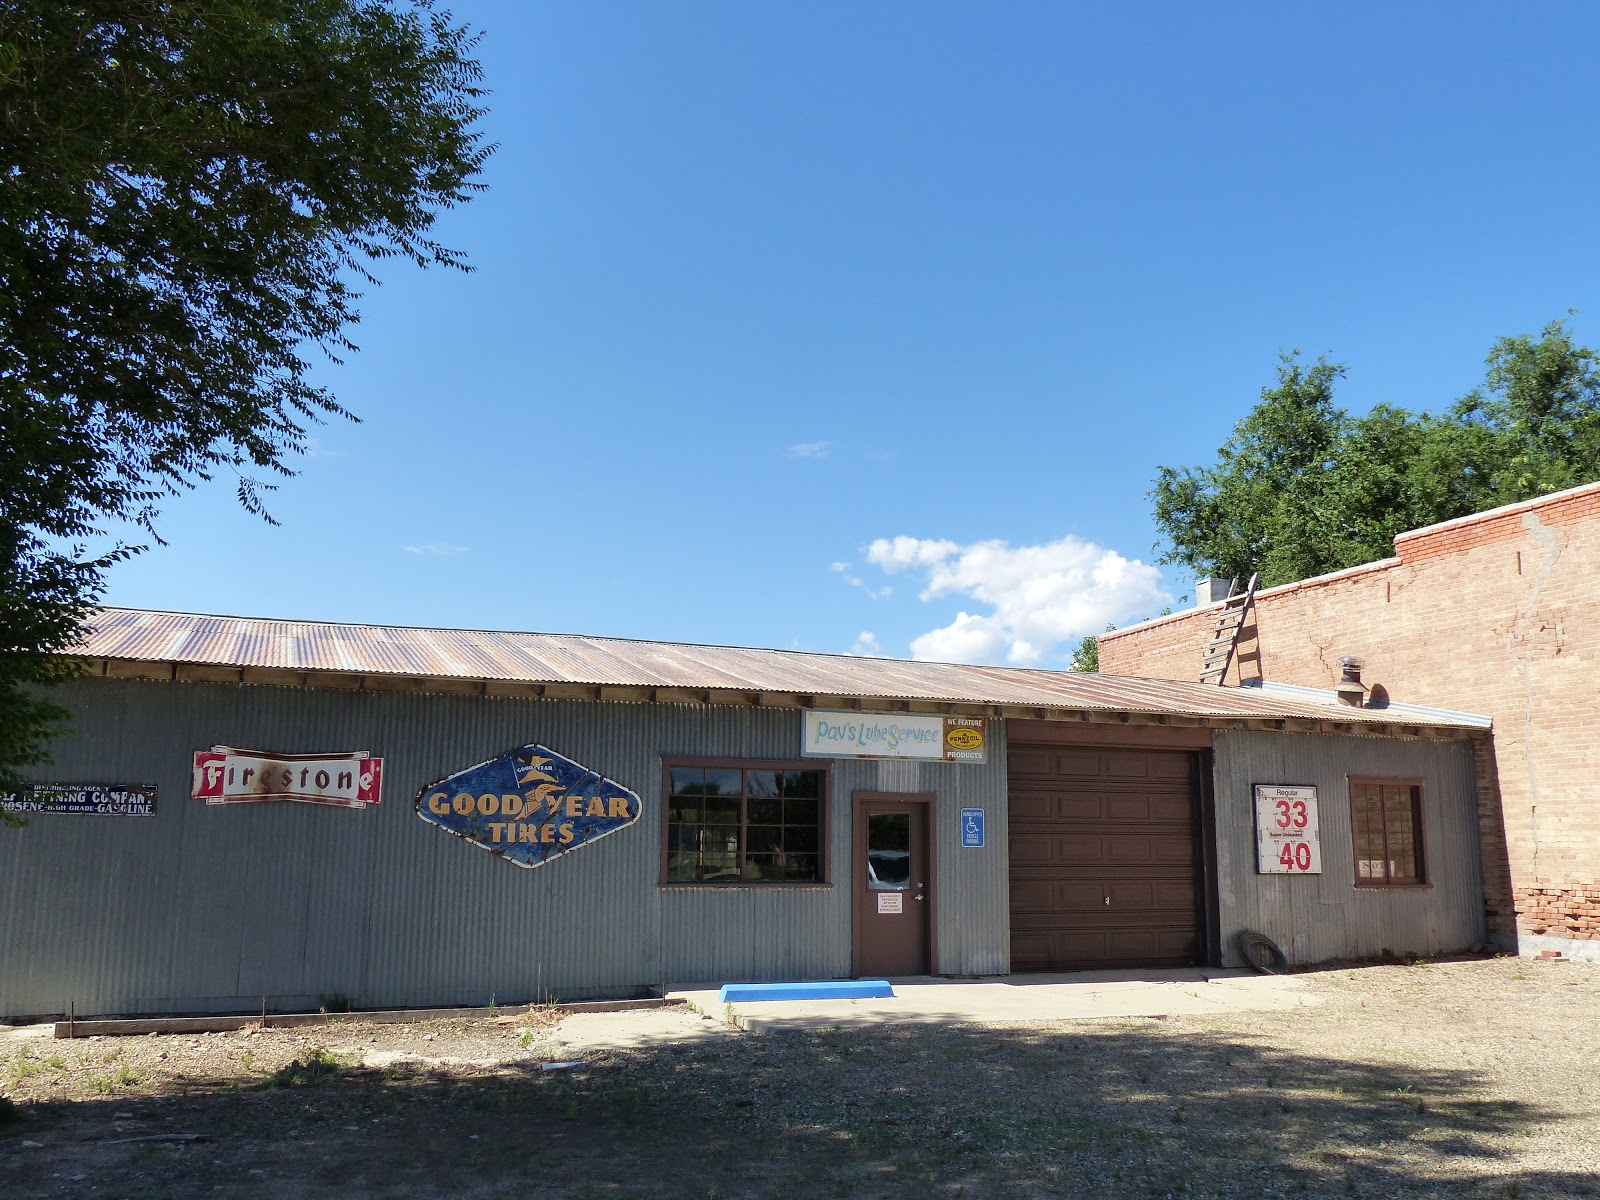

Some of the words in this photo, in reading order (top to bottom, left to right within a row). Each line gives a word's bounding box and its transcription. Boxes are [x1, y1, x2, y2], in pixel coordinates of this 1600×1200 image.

[815, 721, 856, 744] Pav's
[857, 723, 888, 748] Lube
[888, 724, 939, 749] Service
[958, 719, 983, 727] FEATURE
[947, 751, 983, 759] PRODUCTS
[203, 759, 374, 791] Firestone
[1276, 789, 1299, 797] Regular
[1275, 800, 1308, 828] 33
[489, 822, 574, 844] TIRES
[1279, 842, 1312, 871] 40
